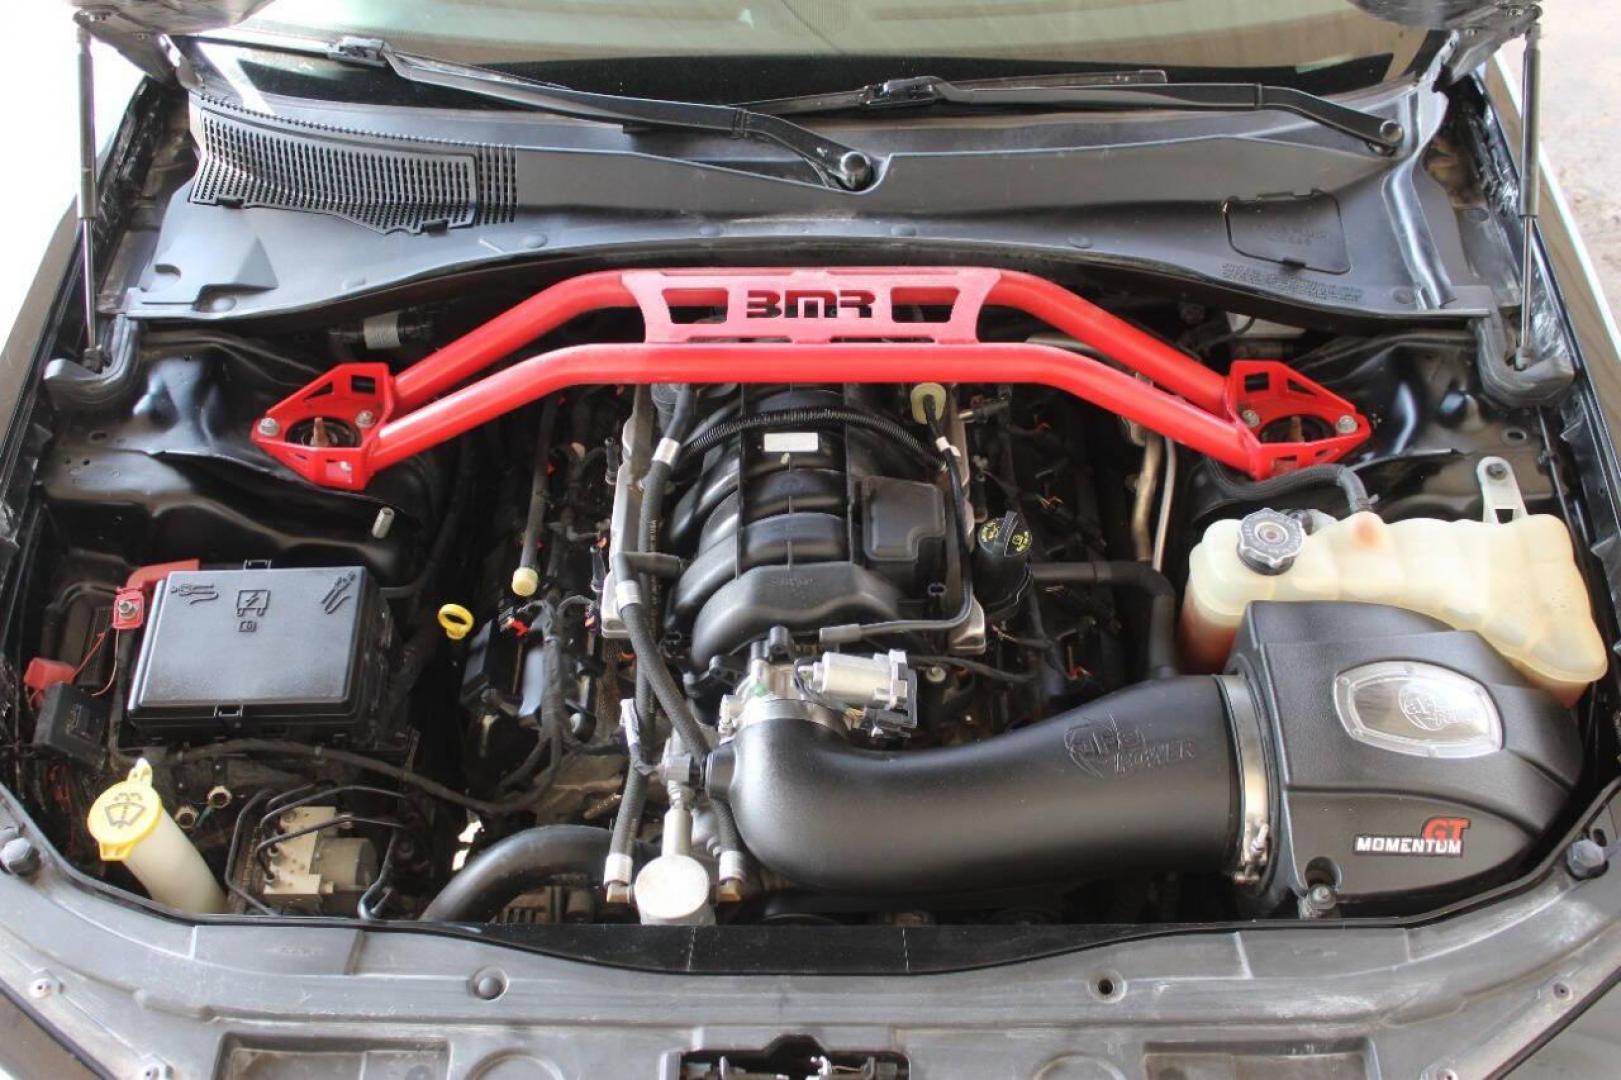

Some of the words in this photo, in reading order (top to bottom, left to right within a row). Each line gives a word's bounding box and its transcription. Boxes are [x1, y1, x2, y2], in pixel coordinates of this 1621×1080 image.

[747, 289, 876, 319] BMR
[1423, 817, 1471, 841] GT
[1356, 836, 1462, 855] MOMENTUM
